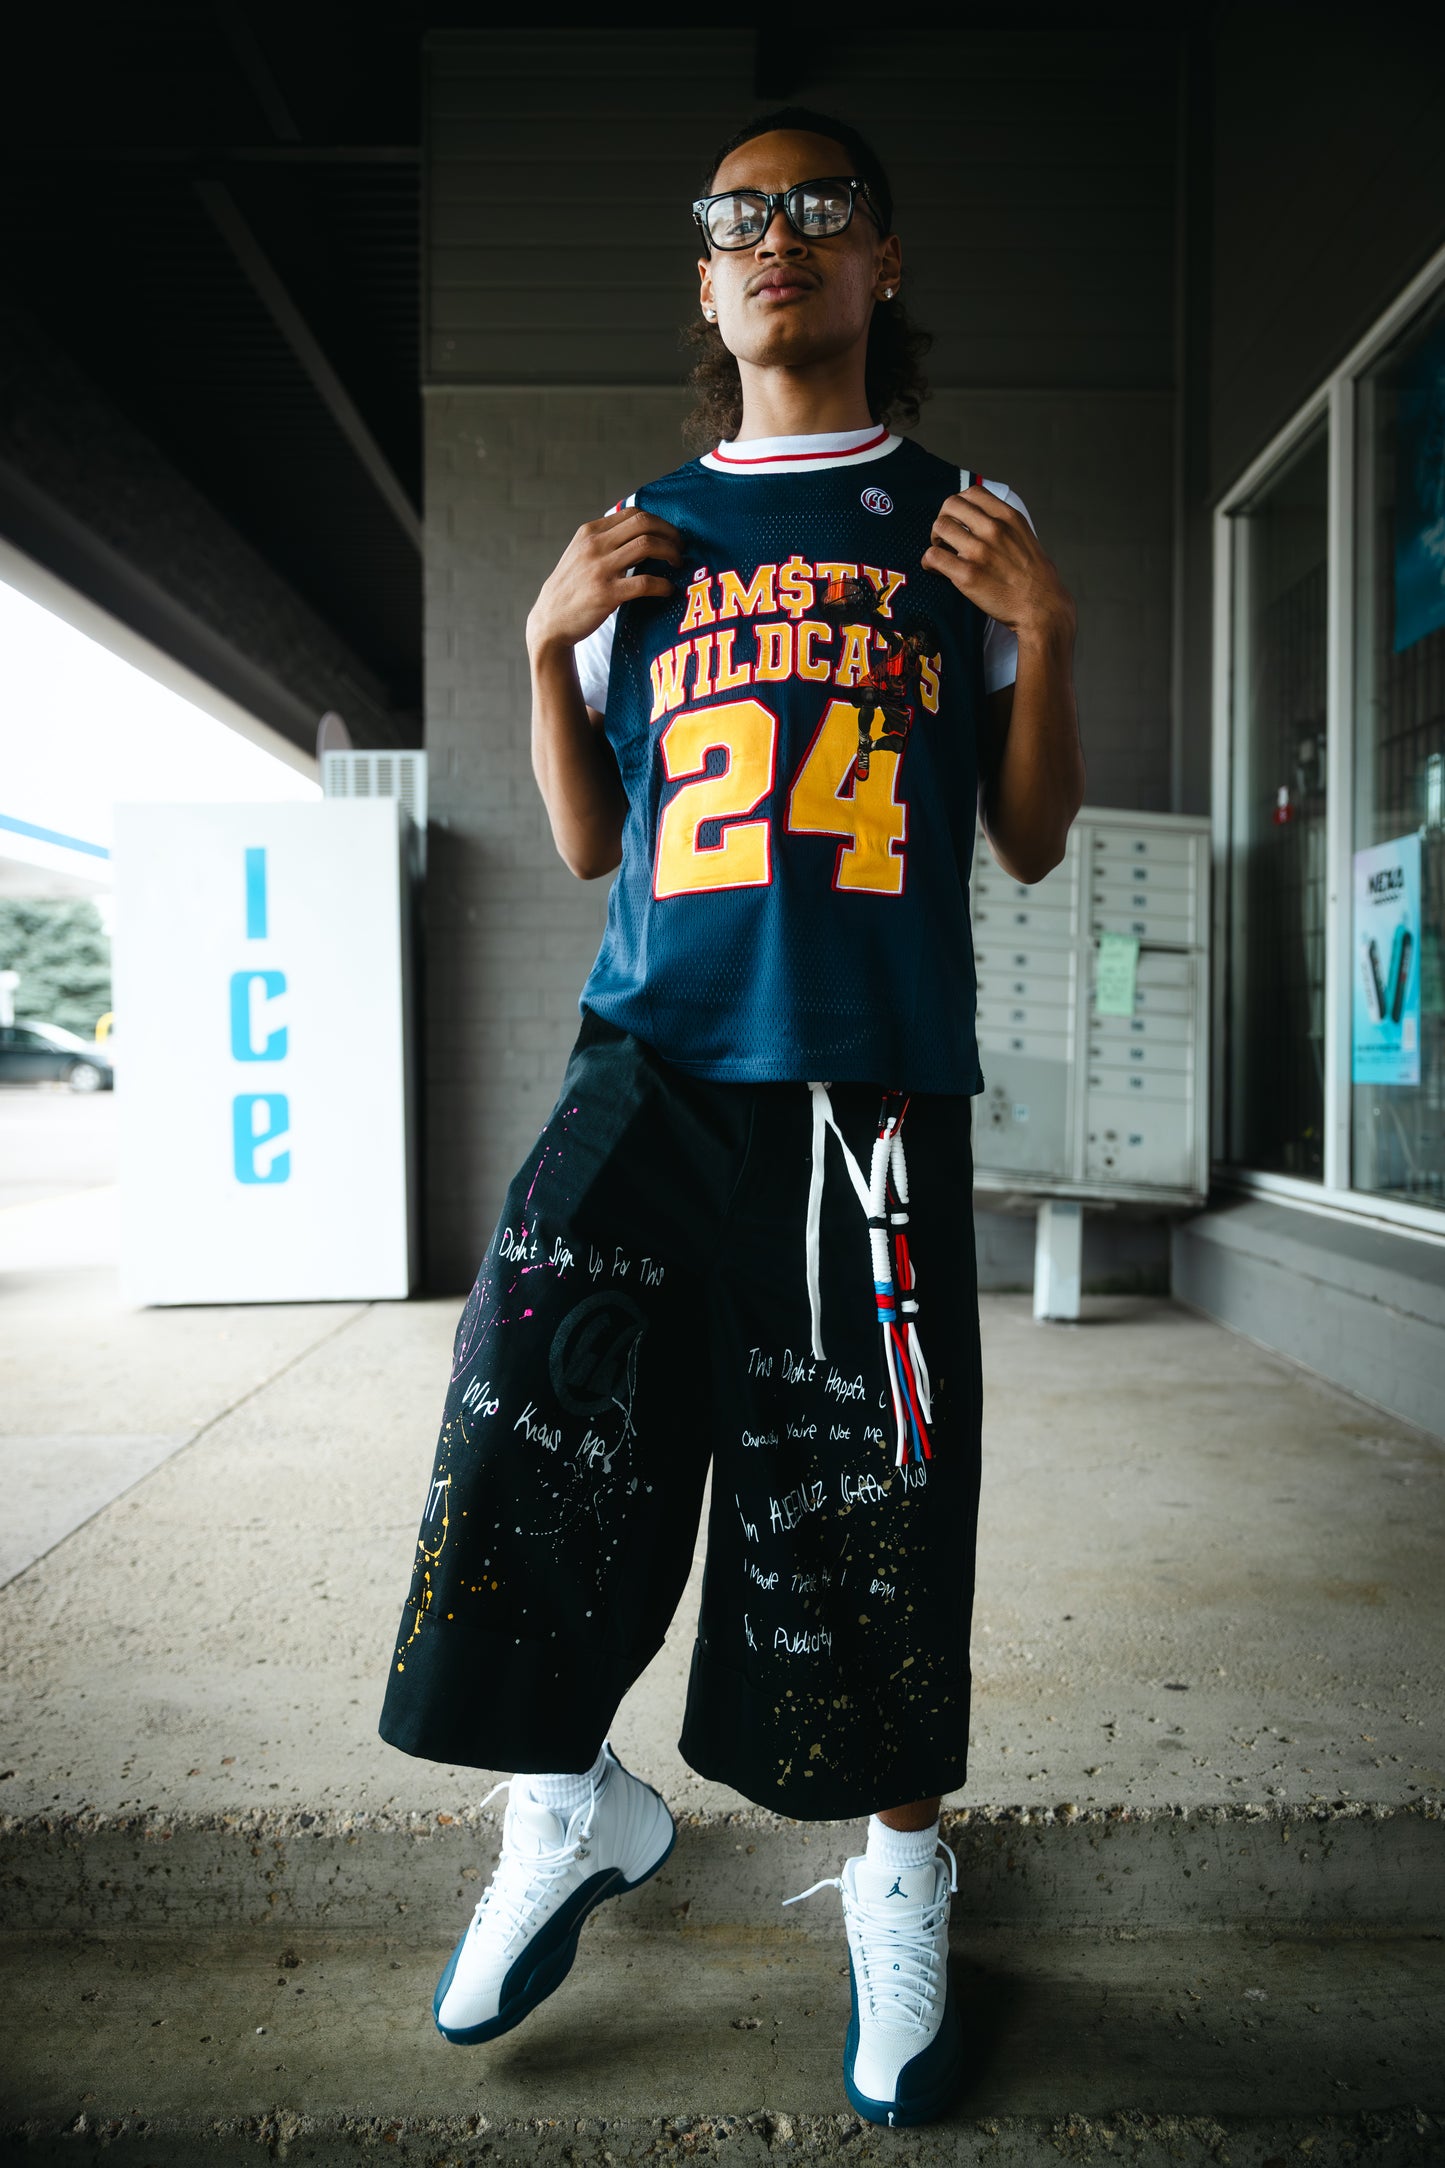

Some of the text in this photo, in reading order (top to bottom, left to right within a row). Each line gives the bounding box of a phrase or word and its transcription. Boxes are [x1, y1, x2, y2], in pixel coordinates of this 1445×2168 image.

[650, 619, 942, 724] WILDCAS
[653, 696, 913, 901] 24
[549, 1236, 576, 1277] Sign
[588, 1243, 604, 1282] Up
[611, 1246, 631, 1277] For
[639, 1257, 665, 1287] This
[747, 1347, 773, 1378] This
[823, 1365, 866, 1404] Happen
[461, 1374, 606, 1469] Who Knows Me
[829, 1424, 852, 1441] Not
[863, 1425, 883, 1443] Me
[749, 1563, 779, 1591] Made
[773, 1625, 833, 1656] Publicity
